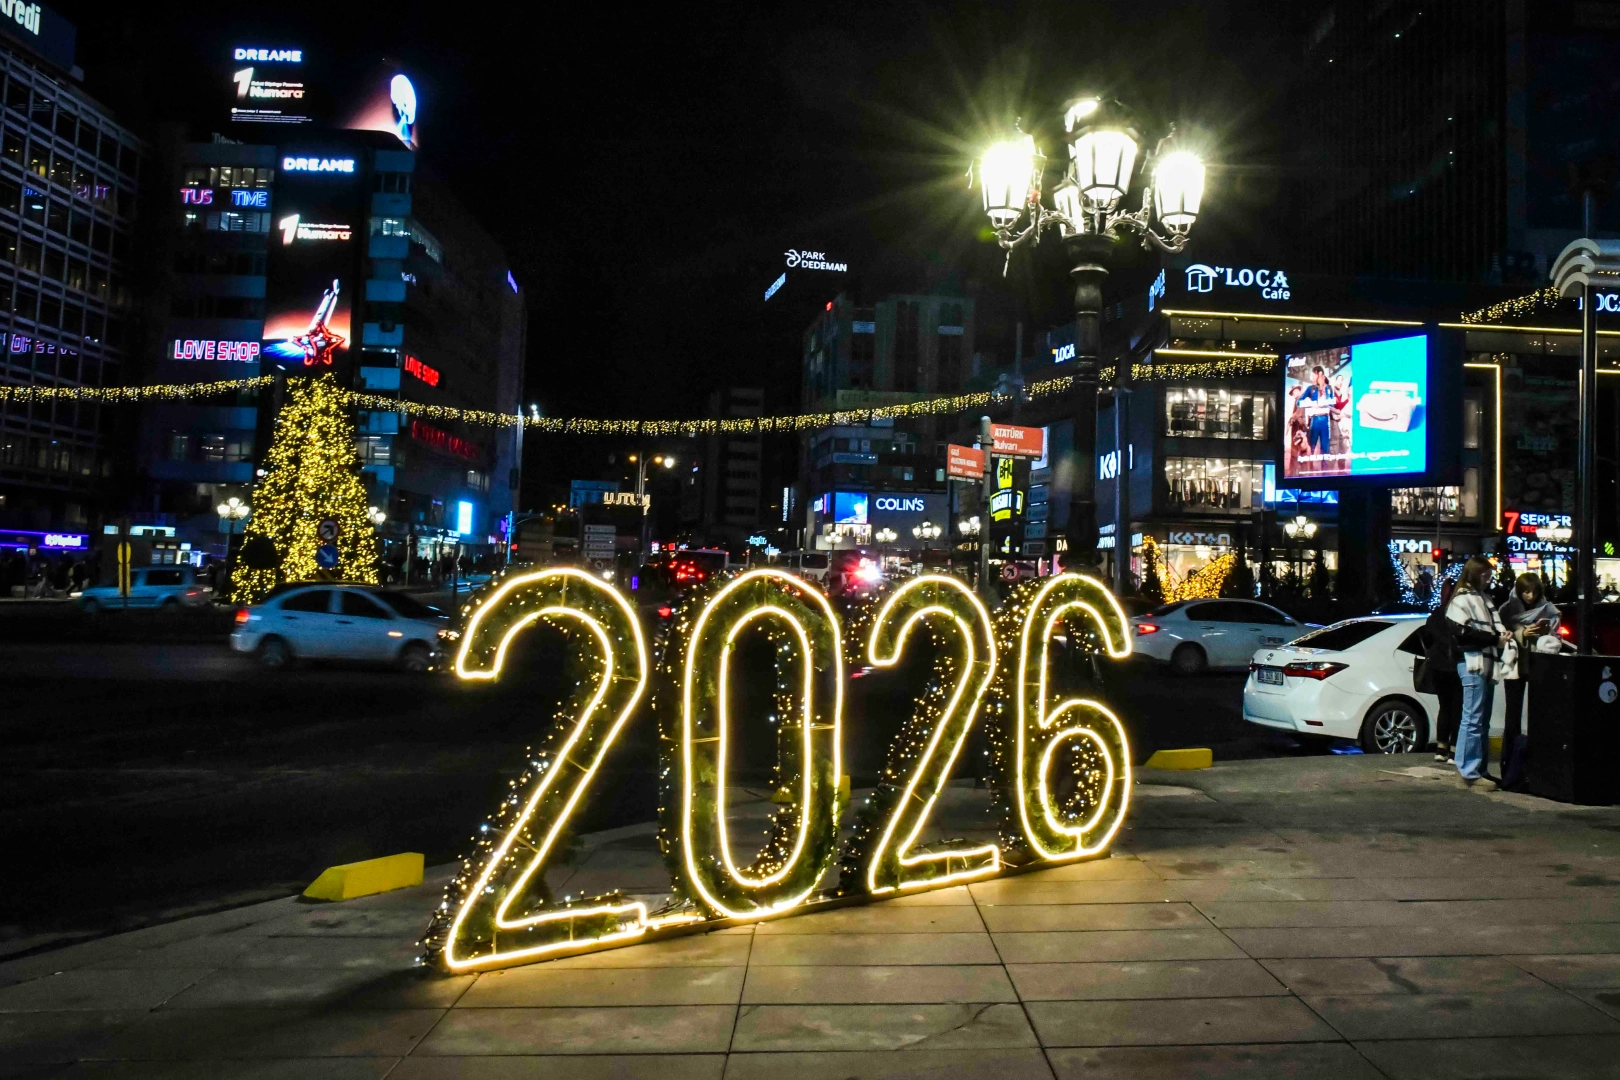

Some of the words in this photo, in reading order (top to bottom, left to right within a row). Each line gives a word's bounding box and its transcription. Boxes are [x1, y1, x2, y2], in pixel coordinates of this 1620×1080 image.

[234, 48, 302, 62] DREAME
[250, 86, 303, 98] Numara
[283, 157, 355, 173] DREAME
[232, 190, 268, 207] TIME
[801, 250, 826, 261] PARK
[801, 260, 848, 273] DEDEMAN
[1225, 268, 1289, 288] LOCA
[1262, 288, 1291, 300] Cafe
[174, 339, 216, 360] LOVE
[216, 340, 260, 361] SHOP
[994, 427, 1024, 440] ATATÜRK
[875, 497, 925, 512] COLIN'S
[1504, 512, 1520, 534] 7
[1524, 541, 1553, 552] LOCA
[445, 566, 1133, 972] 2026
